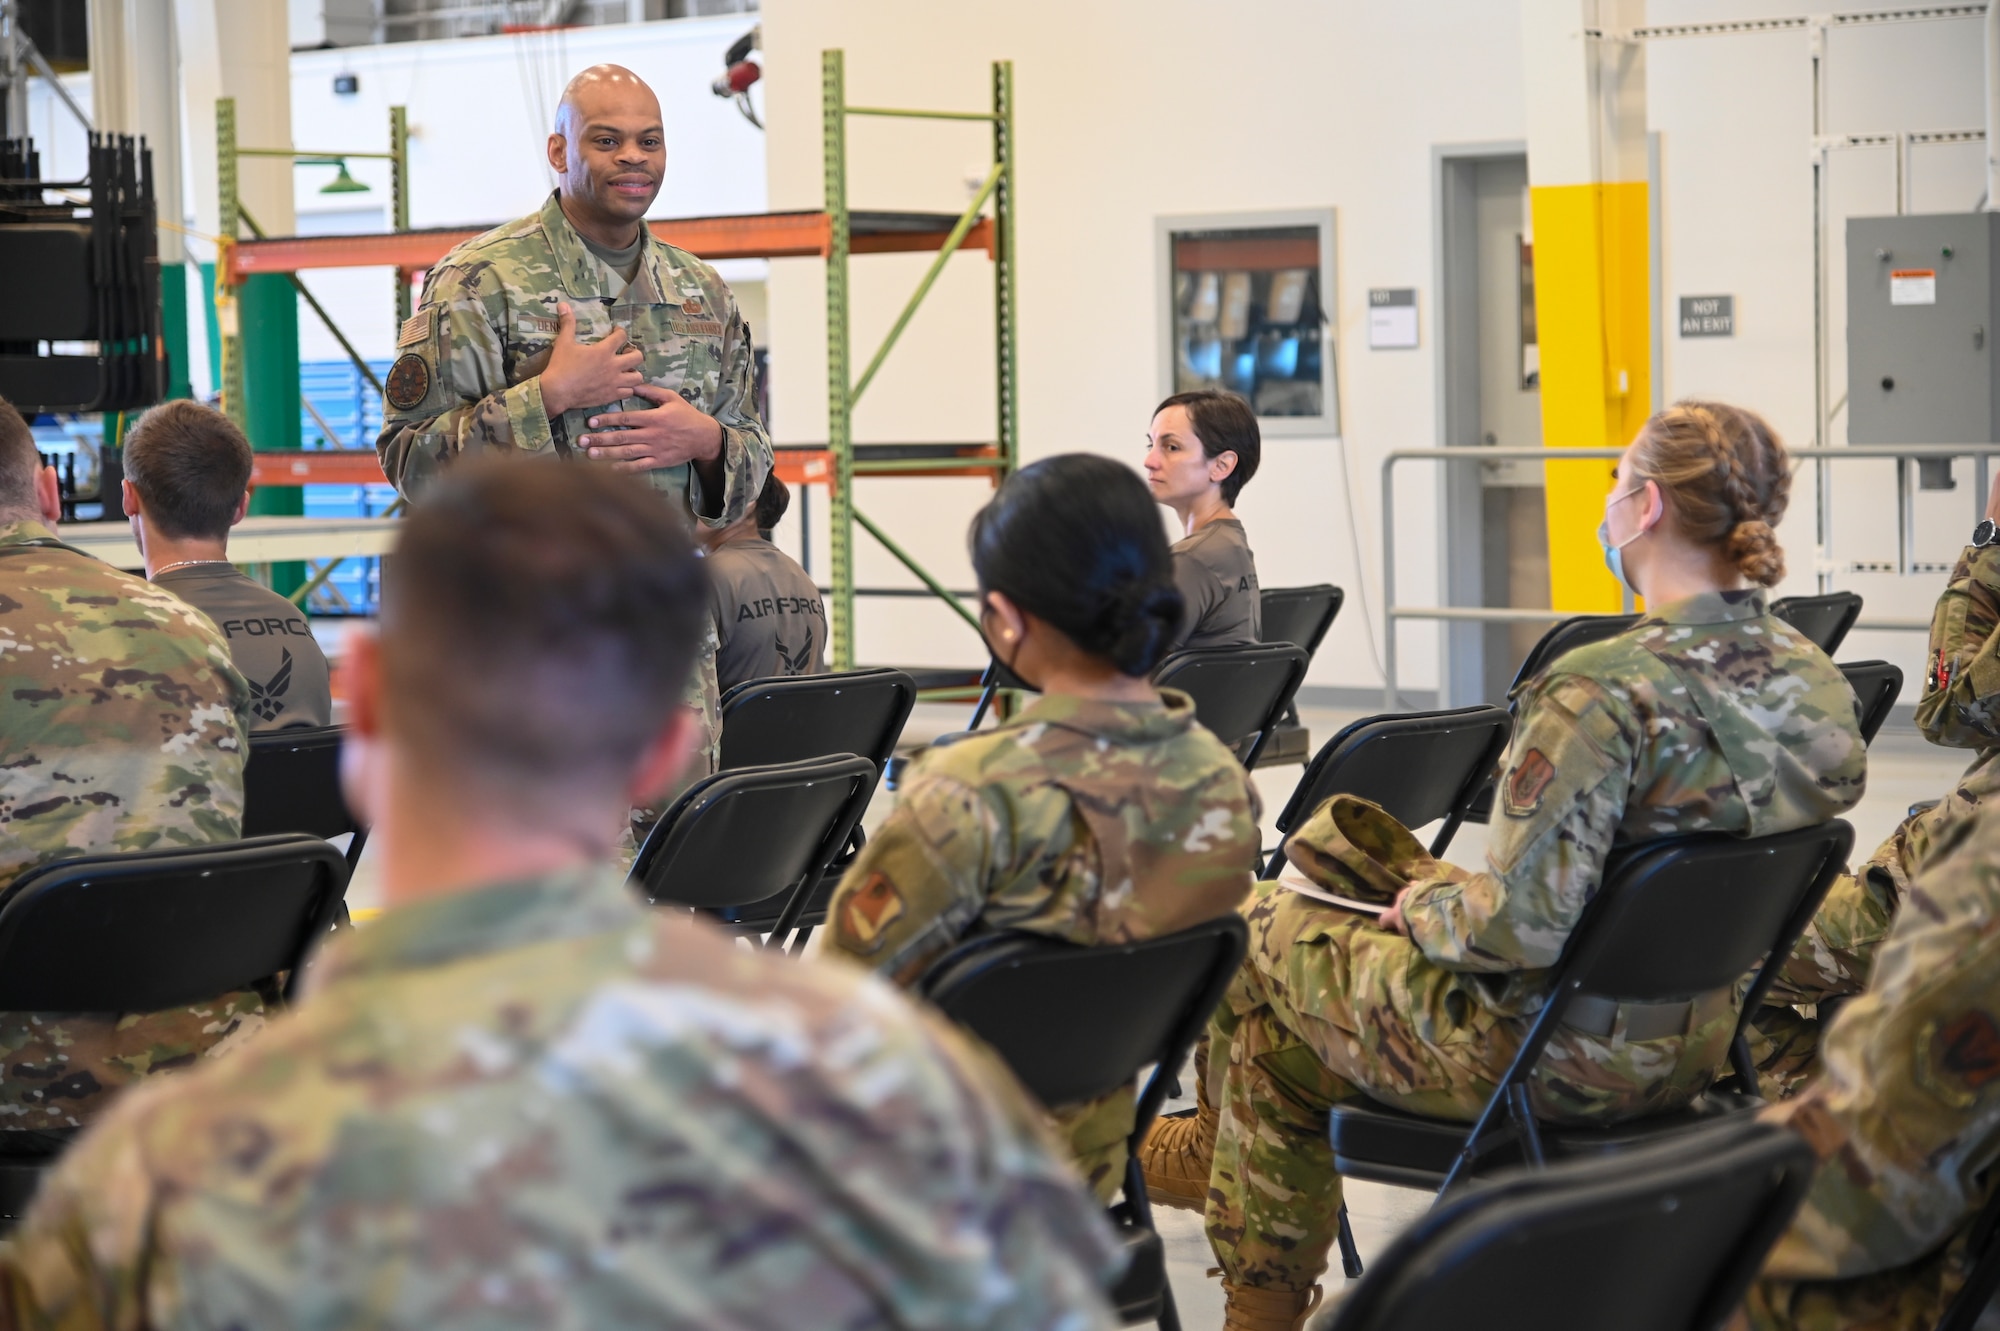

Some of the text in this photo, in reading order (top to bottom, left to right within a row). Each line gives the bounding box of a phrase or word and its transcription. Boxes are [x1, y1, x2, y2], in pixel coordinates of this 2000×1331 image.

[1693, 299, 1718, 315] NOT
[1683, 316, 1730, 332] AN EXIT
[737, 598, 775, 622] AIR
